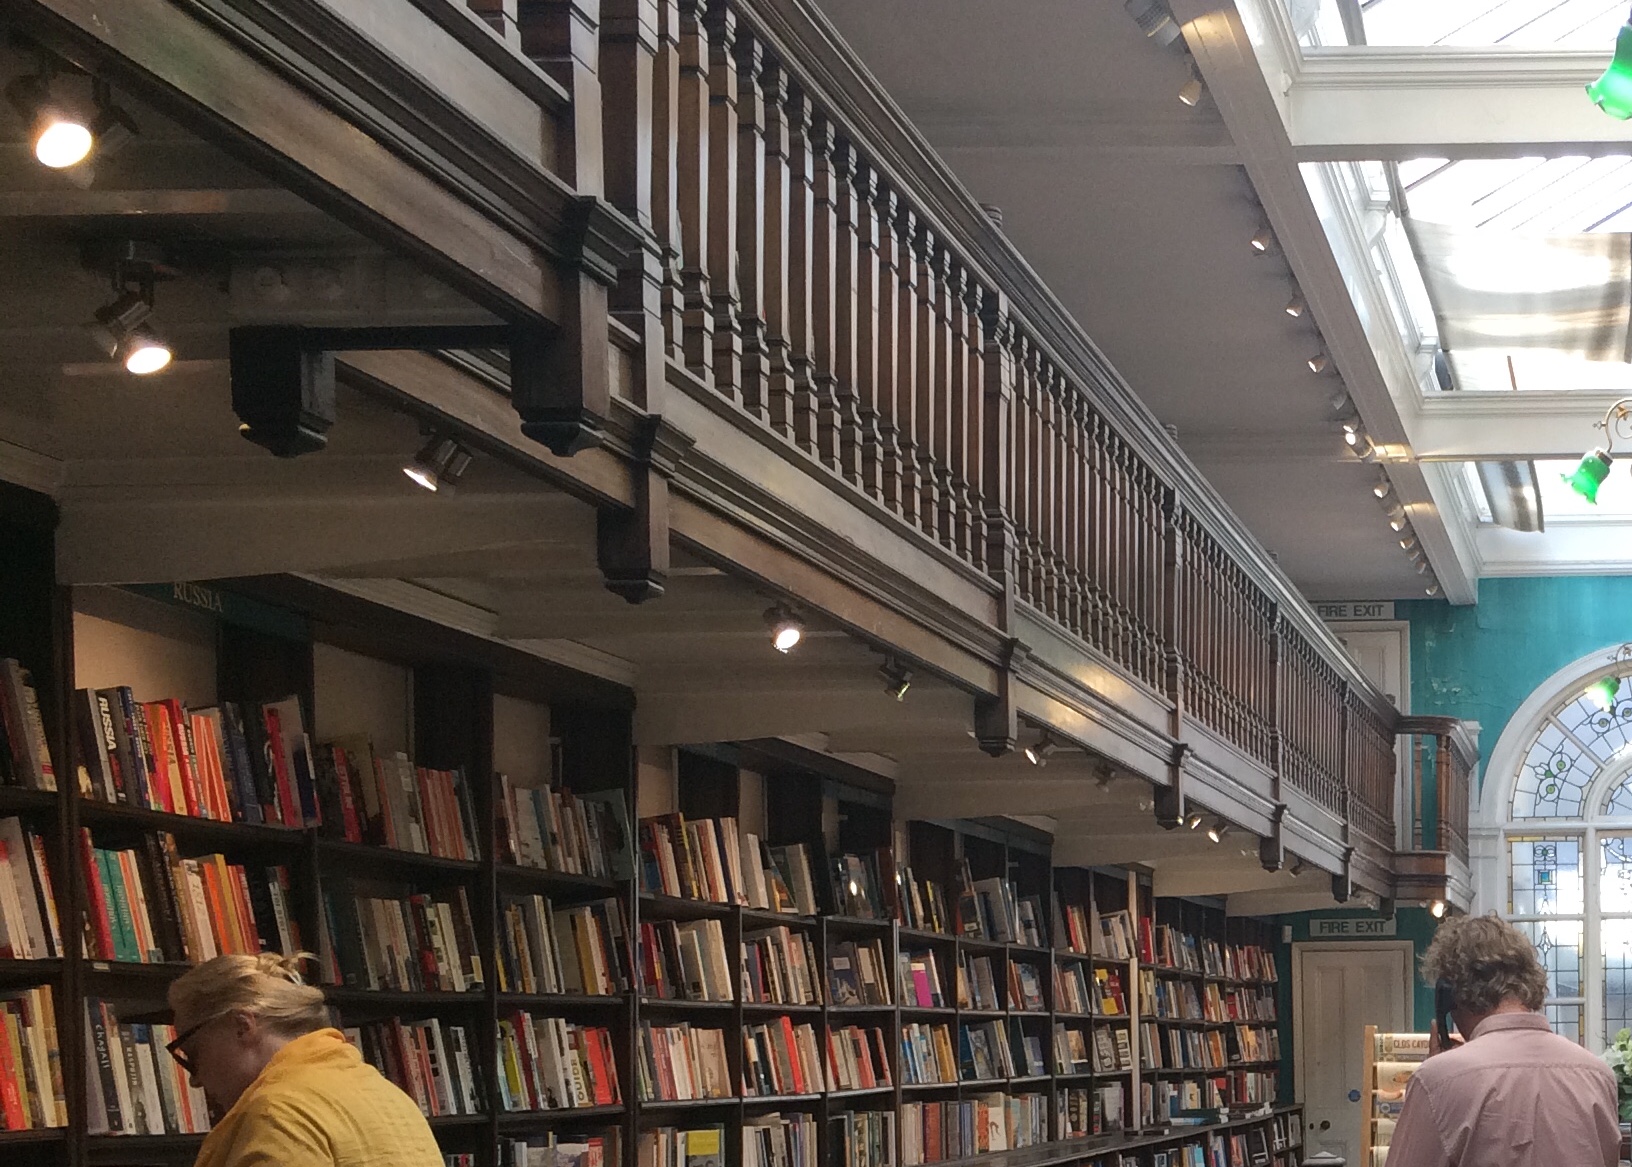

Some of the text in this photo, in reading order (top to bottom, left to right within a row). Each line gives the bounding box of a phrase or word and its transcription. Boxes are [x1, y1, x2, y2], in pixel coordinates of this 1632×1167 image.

[1318, 605, 1384, 617] FIRE EXIT
[98, 697, 117, 750] RUSSIA
[1319, 921, 1386, 934] FIRE EXIT
